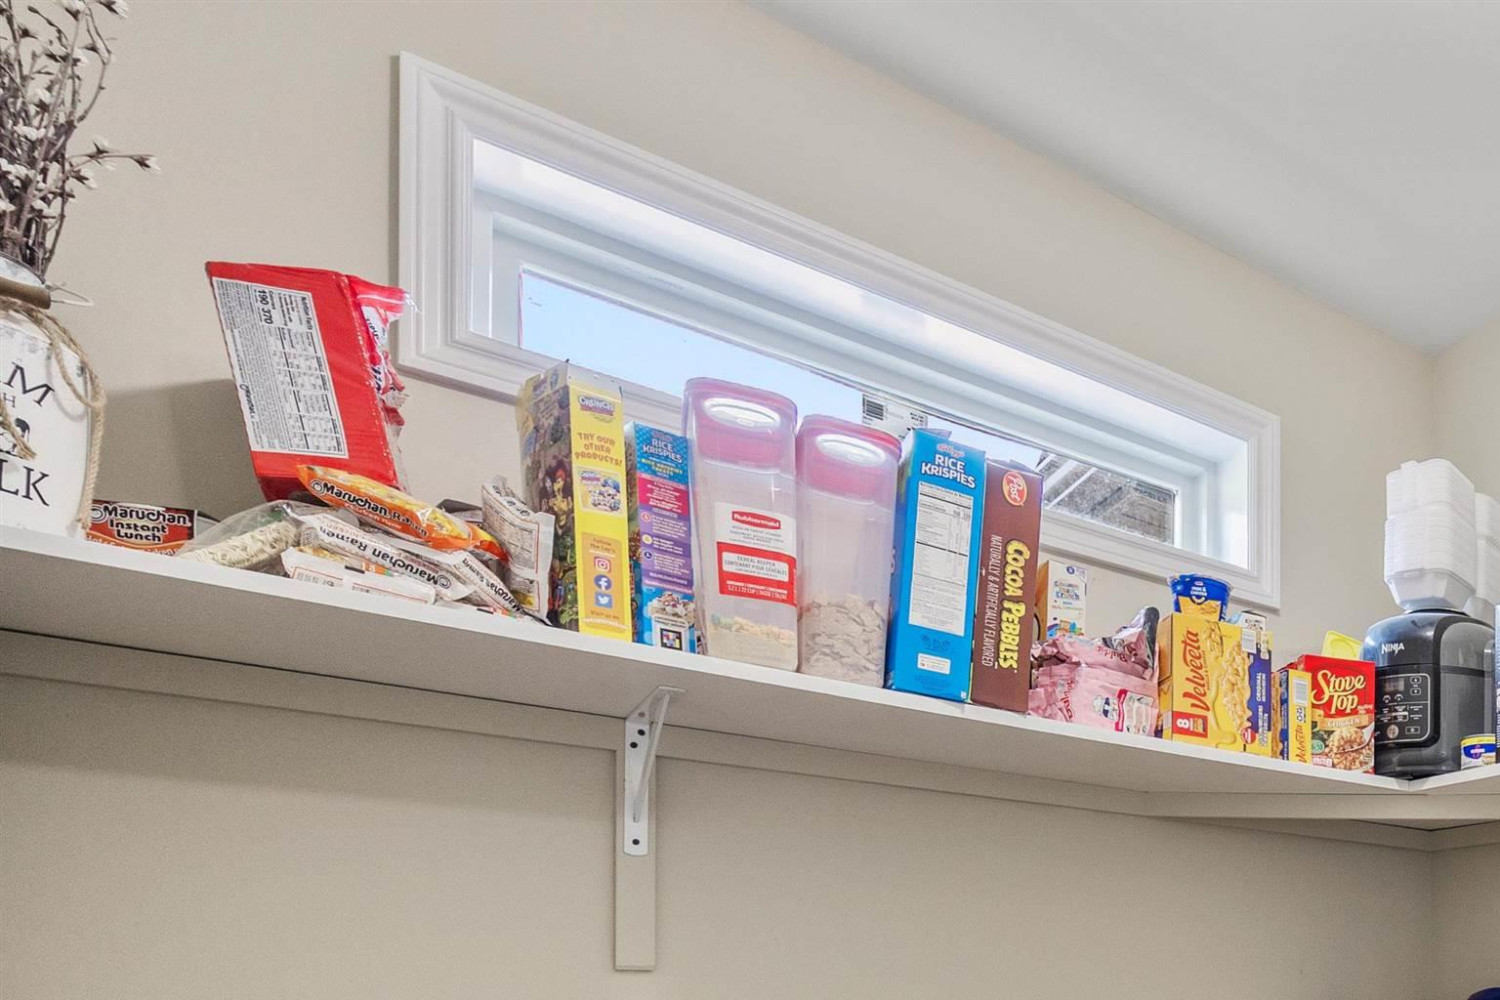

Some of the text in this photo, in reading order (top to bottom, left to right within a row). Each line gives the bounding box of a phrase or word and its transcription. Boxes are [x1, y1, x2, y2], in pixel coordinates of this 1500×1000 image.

[261, 307, 273, 324] 370
[642, 444, 683, 464] KRISPIES
[652, 438, 674, 452] RICE
[935, 454, 966, 473] RICE
[921, 462, 977, 489] KRISPIES
[1007, 471, 1021, 502] Post
[323, 482, 388, 517] Maruchan
[103, 505, 189, 526] Maruchan
[109, 518, 168, 535] Instant
[733, 513, 780, 527] Rubbermaid
[116, 528, 162, 543] Lunch
[989, 534, 1002, 576] NATURALLY
[371, 548, 440, 588] Maruchan
[985, 581, 999, 628] ARTIFICIALLY
[999, 539, 1030, 671] COCOA PEBBLES
[981, 627, 996, 667] FLAVORED
[1381, 642, 1406, 656] NINJA
[1181, 628, 1211, 712] Velveeta
[1311, 669, 1366, 705] Stove
[1328, 692, 1358, 715] Top
[1176, 717, 1190, 729] 8
